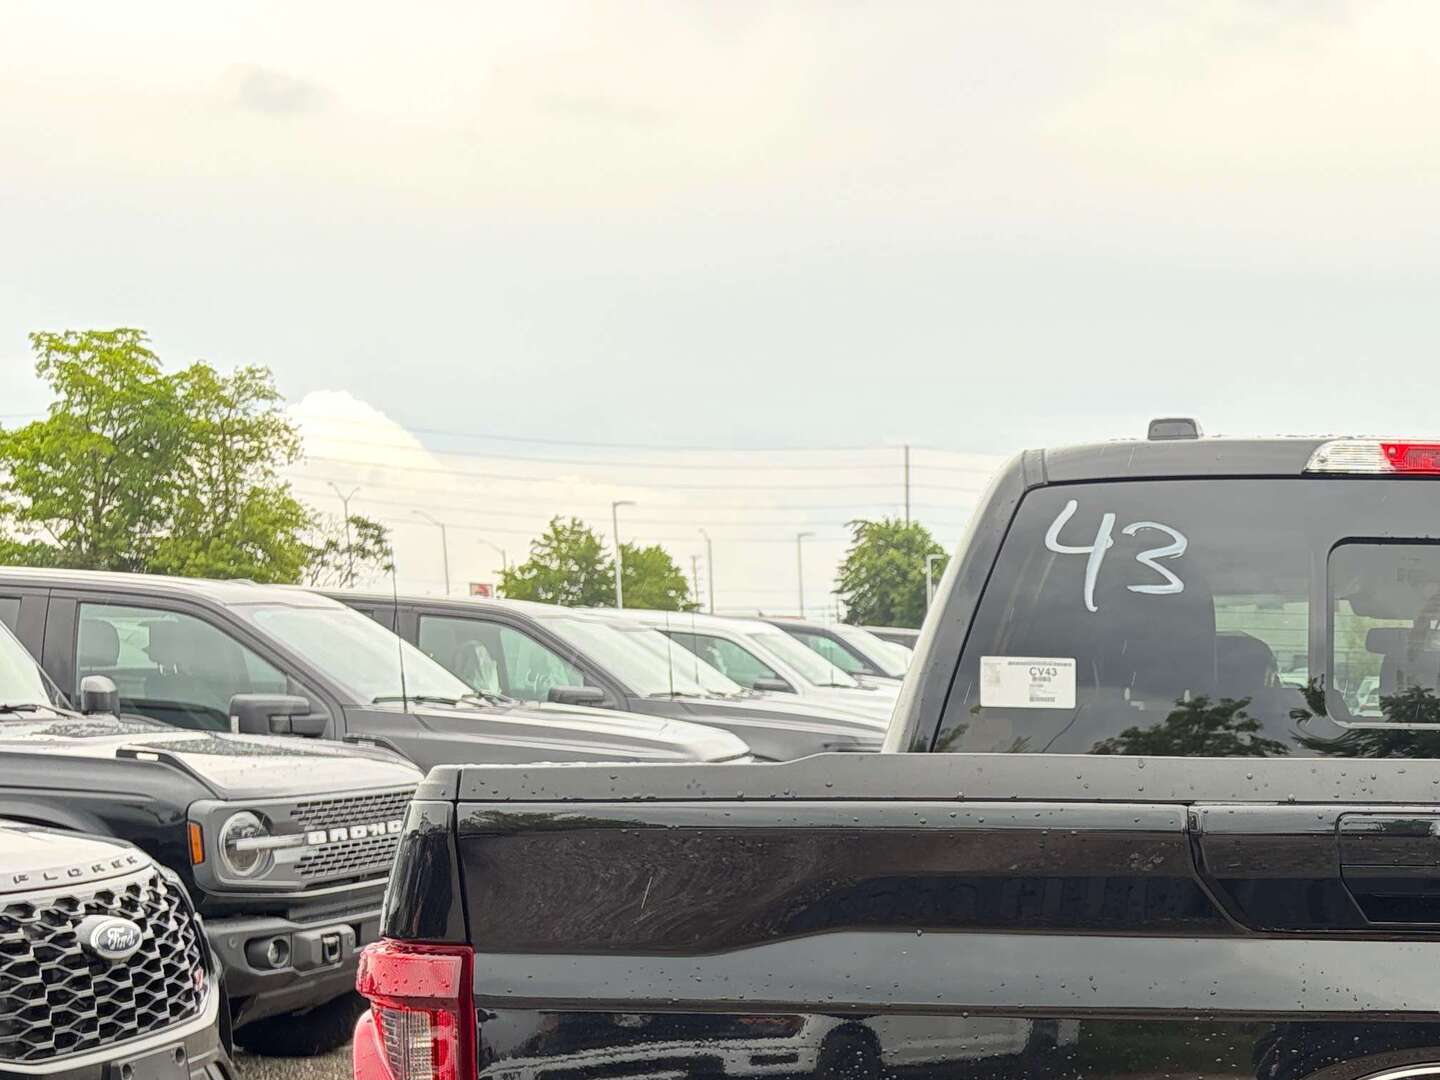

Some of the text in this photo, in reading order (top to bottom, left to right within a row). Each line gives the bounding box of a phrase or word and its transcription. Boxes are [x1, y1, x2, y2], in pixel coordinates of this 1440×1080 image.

[1045, 500, 1188, 612] 43
[1028, 666, 1058, 677] CV43
[107, 926, 135, 951] Ford
